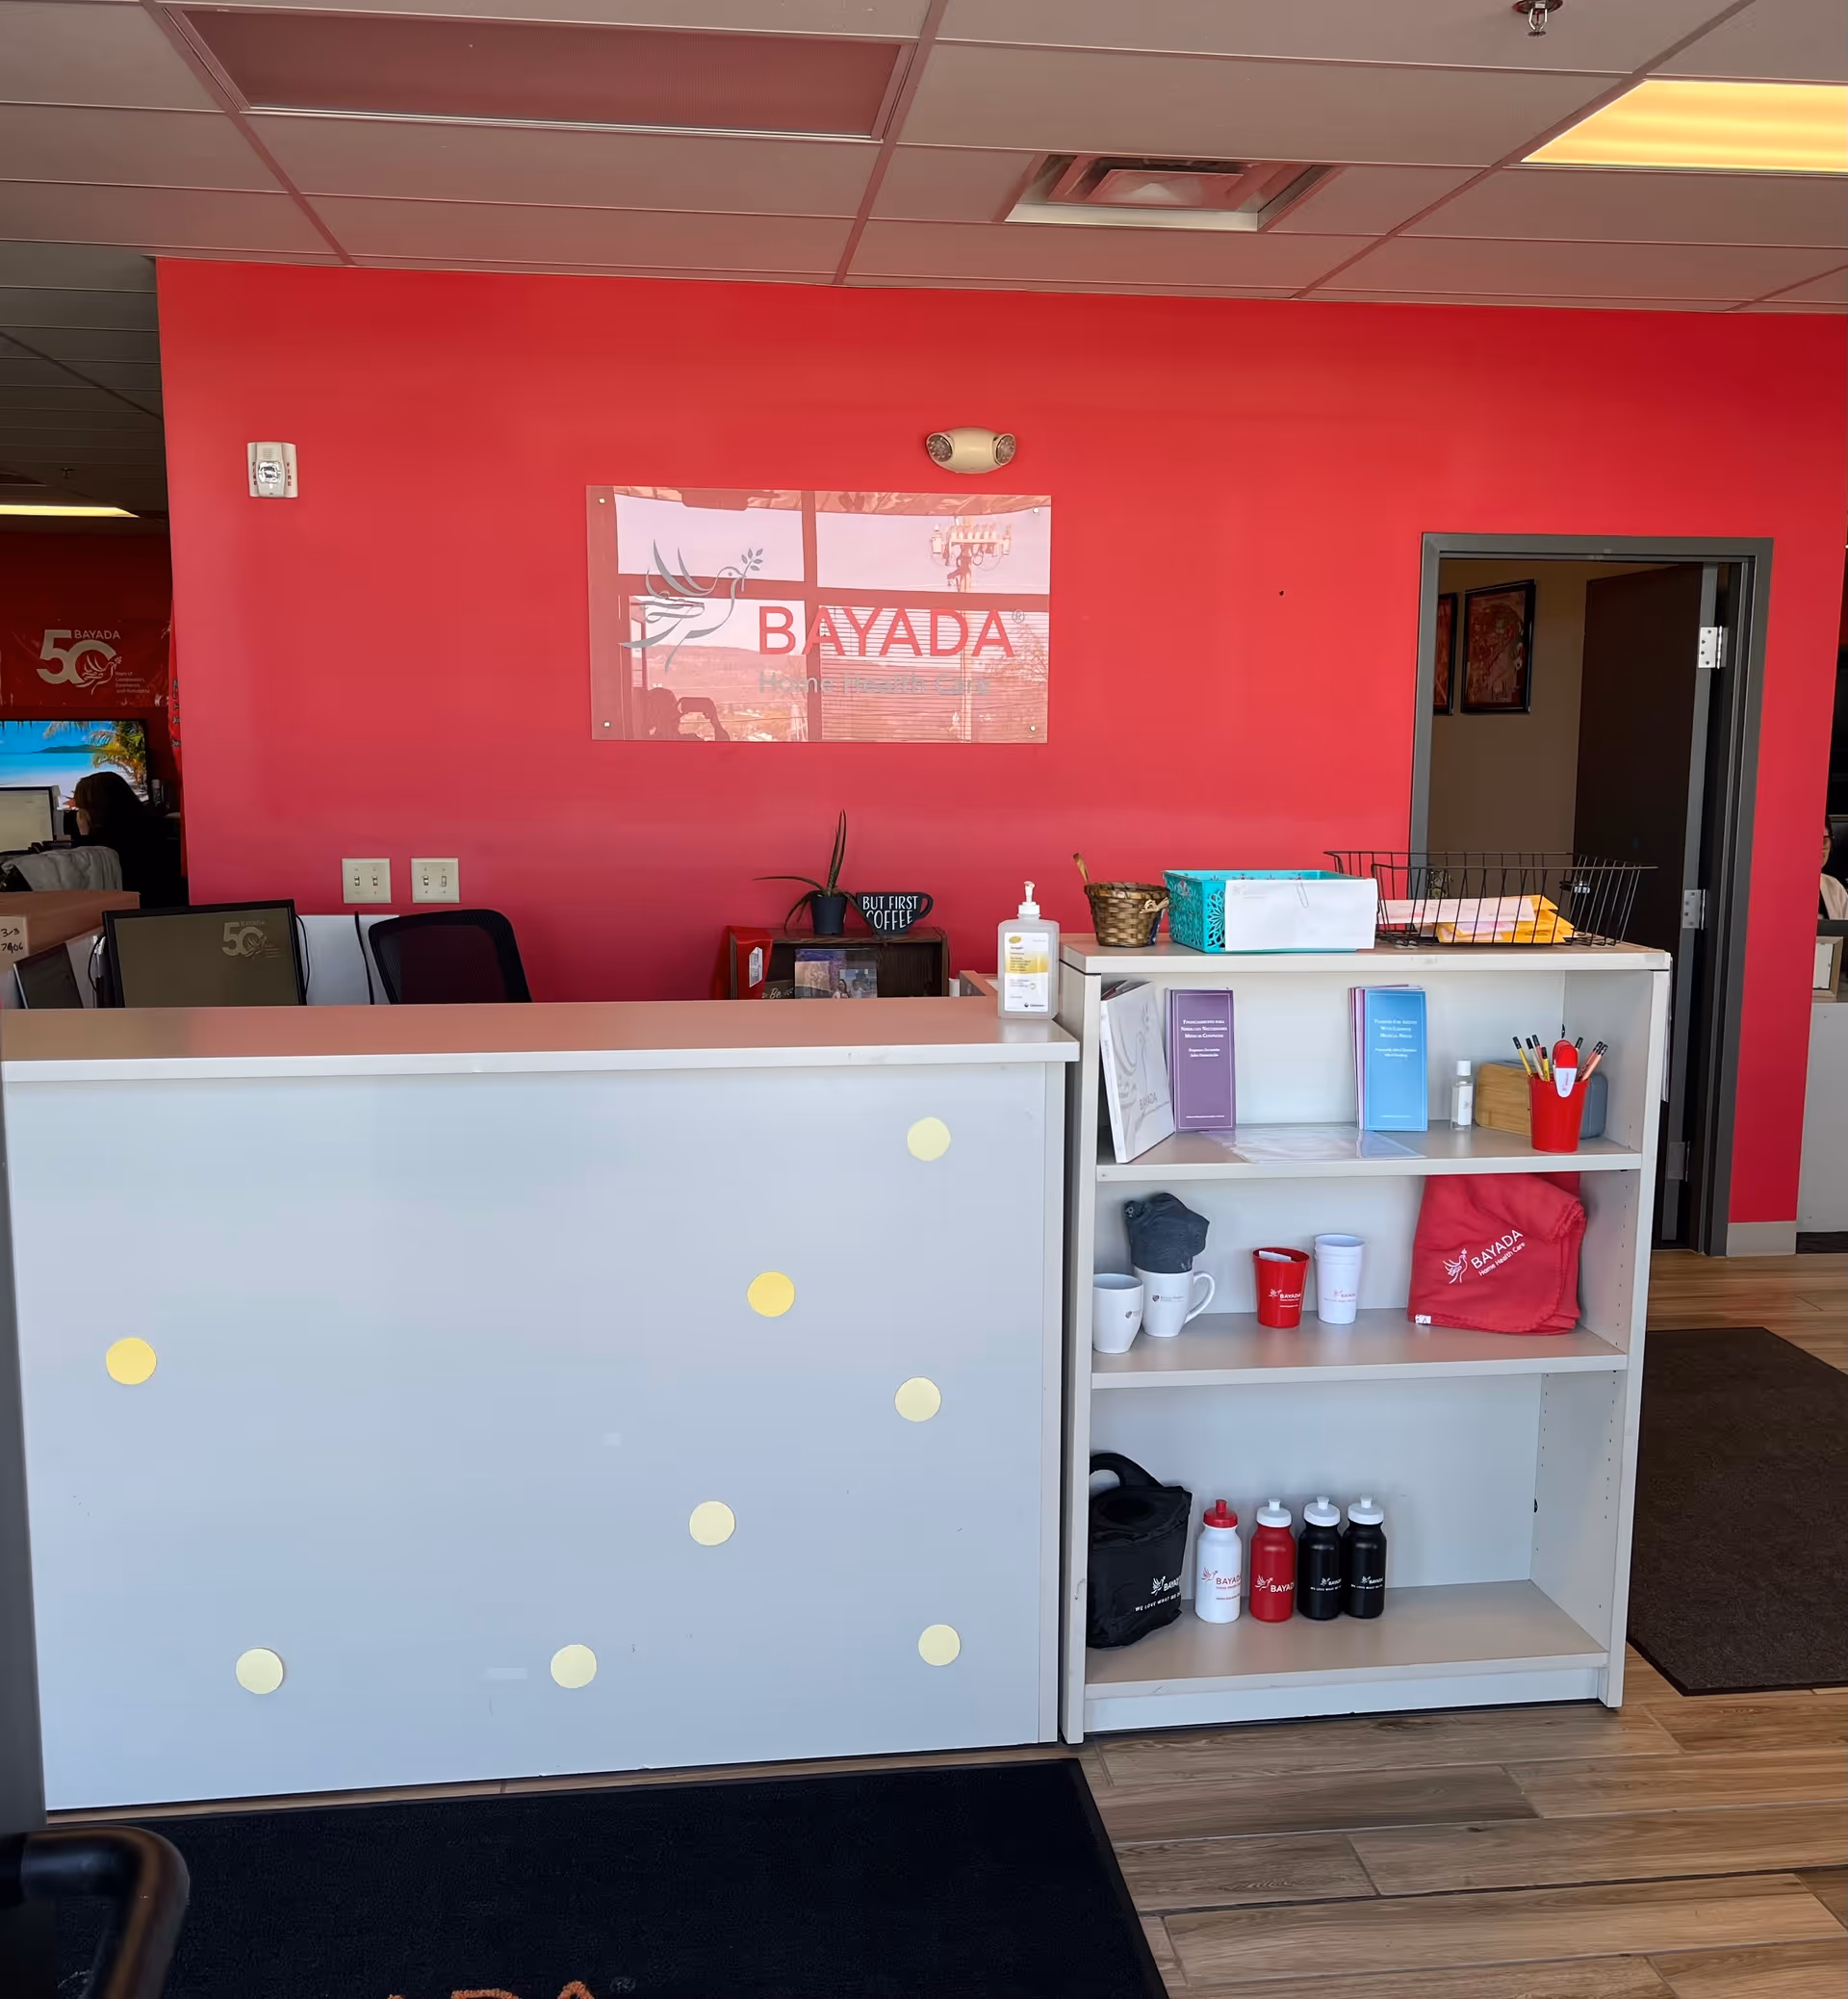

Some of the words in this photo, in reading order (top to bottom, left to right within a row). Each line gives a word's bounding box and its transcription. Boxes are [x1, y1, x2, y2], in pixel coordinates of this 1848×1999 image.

[74, 629, 121, 640] BAYADA
[758, 671, 834, 694] Home
[842, 671, 925, 694] Health
[935, 673, 990, 695] Care
[862, 895, 885, 910] BUT
[888, 895, 918, 910] FIRST
[1471, 1229, 1524, 1269] BAYADA
[1477, 1263, 1497, 1277] Home
[1494, 1250, 1514, 1267] Health
[1511, 1242, 1527, 1253] Care
